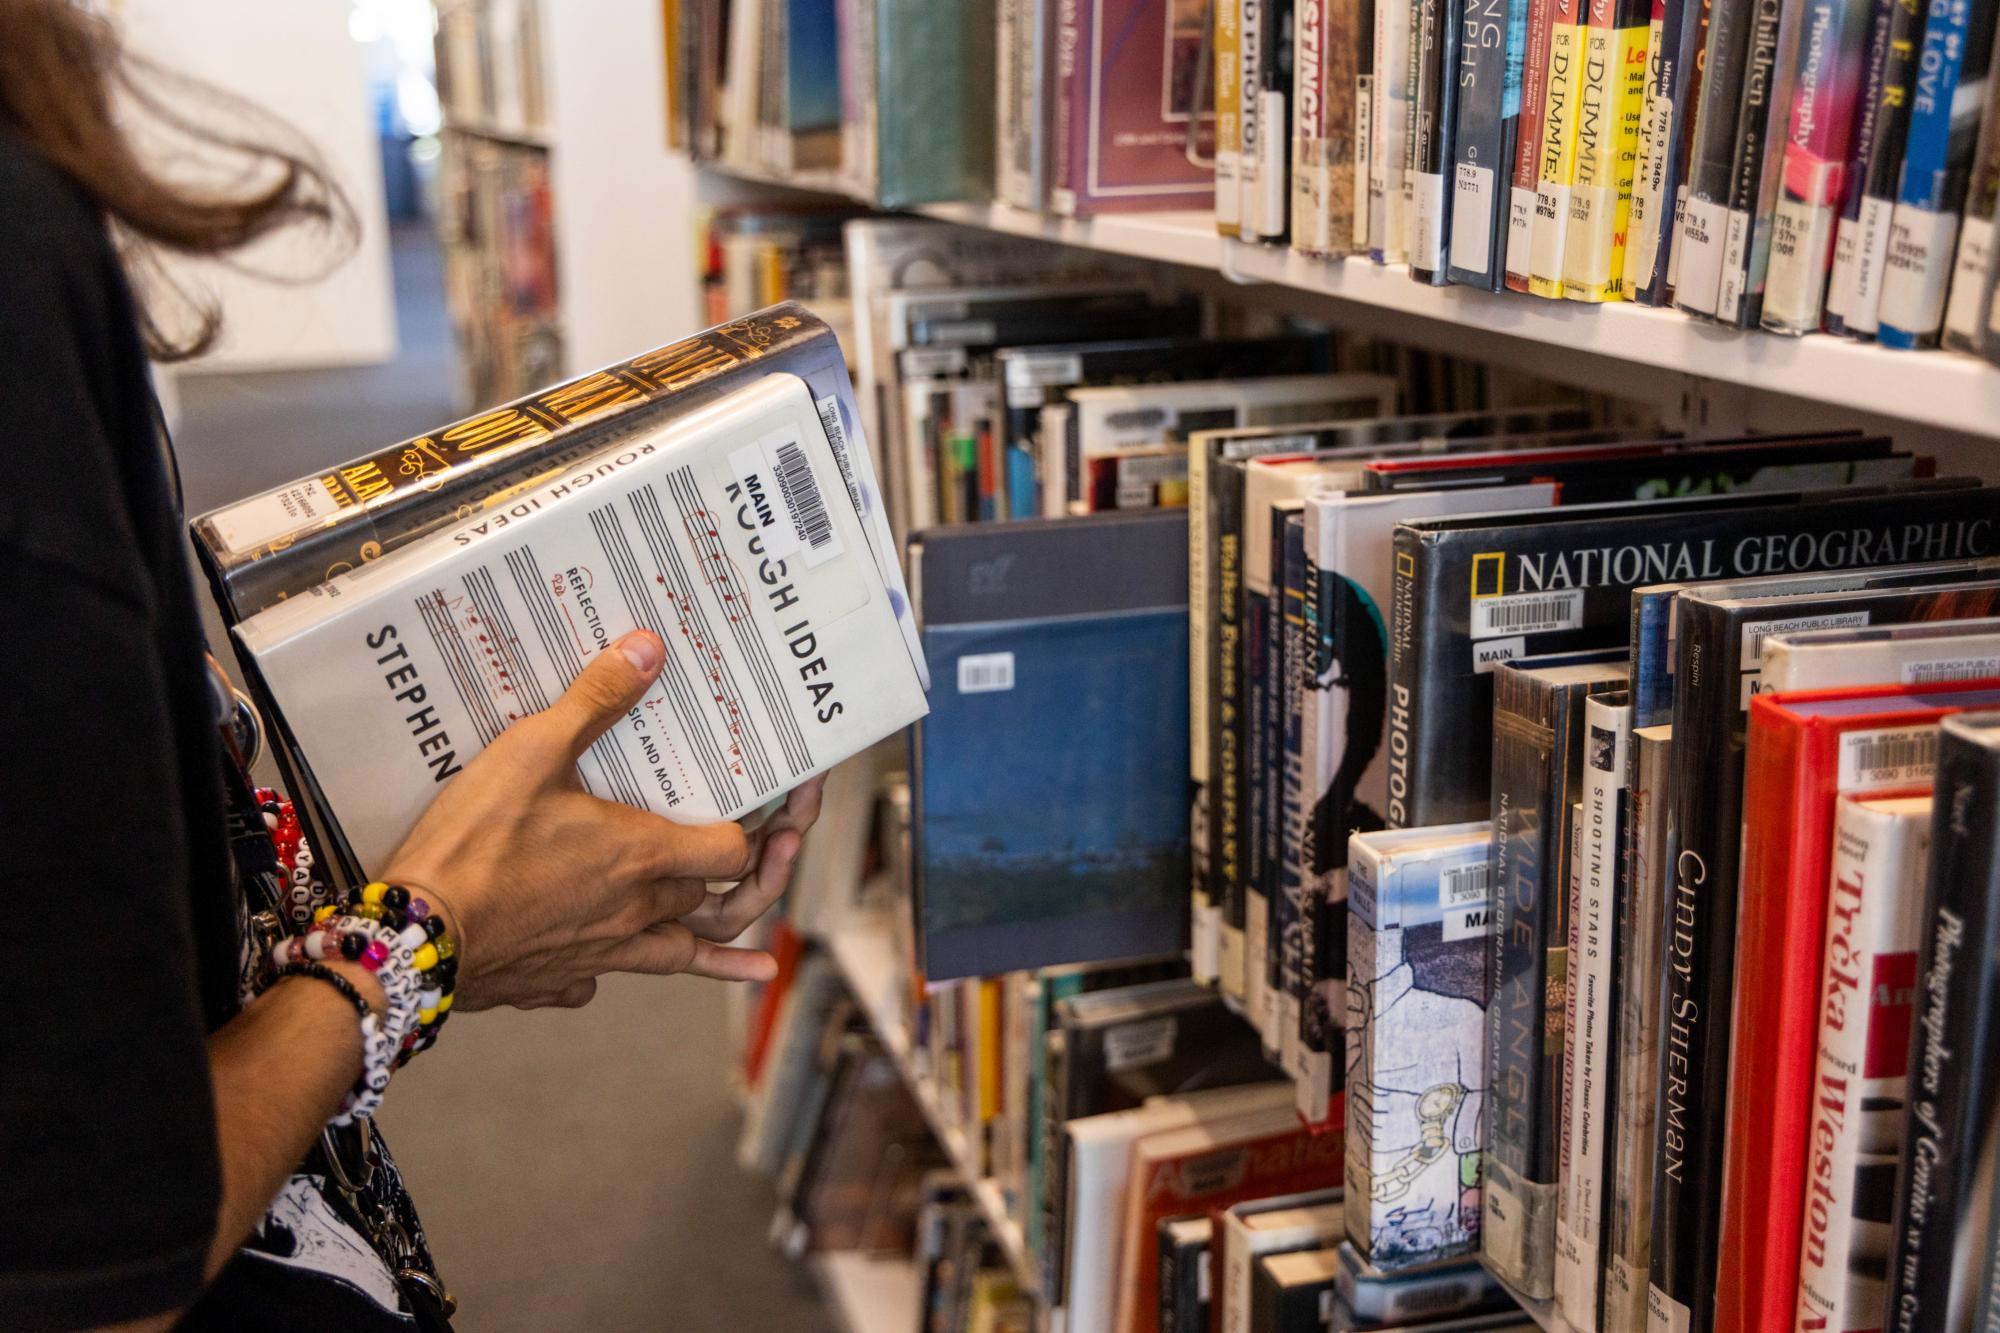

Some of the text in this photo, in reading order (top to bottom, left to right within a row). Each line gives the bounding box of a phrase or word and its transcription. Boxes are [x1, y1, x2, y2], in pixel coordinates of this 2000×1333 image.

[1556, 34, 1570, 46] FOR
[1590, 38, 1605, 50] FOR
[1913, 29, 1946, 117] LOVE
[1793, 6, 1832, 150] Photography
[1858, 16, 1889, 164] ENCHANTMENT
[1656, 111, 1668, 148] 778.9
[1537, 193, 1556, 207] 778.9
[1687, 213, 1706, 228] 778.9
[827, 402, 862, 512] LONG BEACH PUBLIC LIBRARY
[453, 442, 657, 547] ROUGH IDEAS
[743, 473, 776, 528] MAIN
[1220, 533, 1238, 623] Walker
[1516, 519, 1992, 593] NATIONAL GEOGRAPHIC
[1403, 579, 1413, 649] NATIONAL
[1748, 615, 1864, 634] LONG BEACH PUBLIC LIBRARY
[783, 619, 844, 724] IDEAS
[1220, 624, 1238, 698] Evans
[1479, 648, 1514, 664] MAIN
[1690, 643, 1702, 687] Respini
[1908, 659, 1996, 673] LONG BEACH PUBLIC
[366, 623, 465, 784] STEPHEN
[1847, 730, 1937, 747] LONG BEACH PUBL
[639, 735, 660, 766] AND
[653, 767, 681, 808] MORE
[1388, 683, 1410, 829] PHOTOG
[1497, 793, 1509, 879] NATIONAL
[1588, 786, 1603, 959] SHOOTING STARS
[1513, 806, 1541, 955] WIDE
[1494, 886, 1506, 999] GEOGRAPHIC
[1561, 875, 1580, 1169] FINE ART FLOWER PHOTOGRAPHY
[1585, 1009, 1594, 1038] Photos
[1587, 974, 1595, 1008] Favorite
[1921, 907, 1967, 1096] Photographers
[1492, 1006, 1502, 1090] GREATEST
[1584, 1039, 1593, 1067] Taken
[1583, 1078, 1592, 1110] Classic
[1913, 1100, 1942, 1139] of
[1581, 1111, 1591, 1156] Celebrities
[1807, 1074, 1848, 1269] Weston
[1910, 1136, 1941, 1226] Genius
